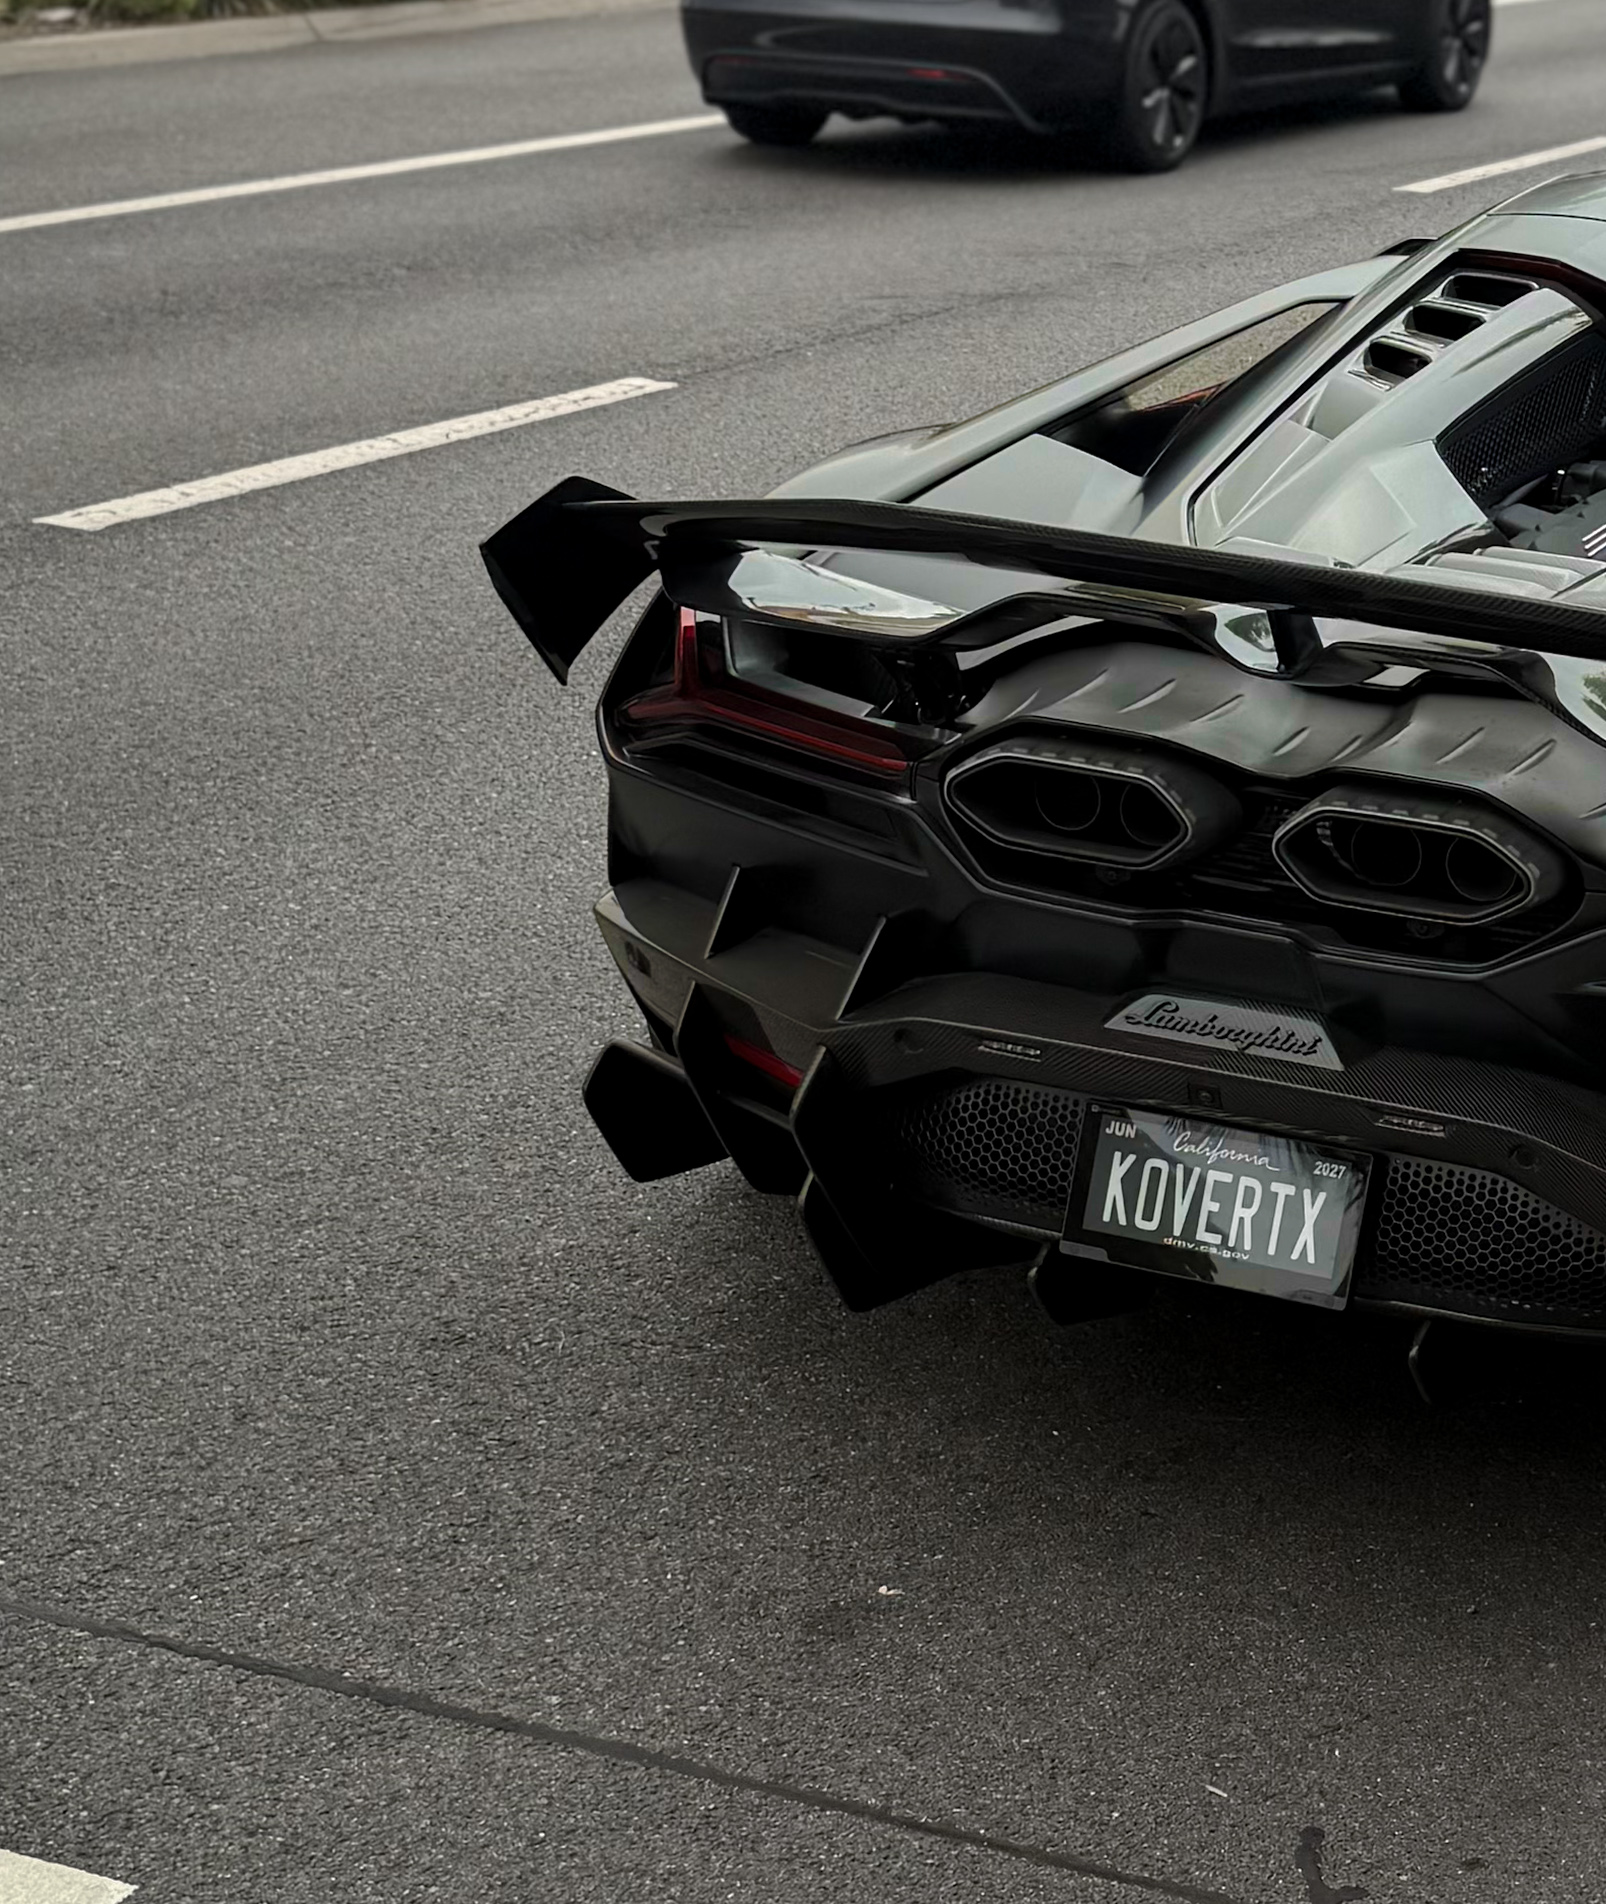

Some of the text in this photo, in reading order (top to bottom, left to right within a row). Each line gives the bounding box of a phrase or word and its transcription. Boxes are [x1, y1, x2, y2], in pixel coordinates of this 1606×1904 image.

[1125, 1000, 1324, 1057] Lamborghini
[1105, 1120, 1137, 1139] JUN
[1173, 1131, 1281, 1172] California
[1313, 1161, 1347, 1180] 2027
[1102, 1151, 1327, 1264] KOVERTX
[1163, 1236, 1250, 1261] dmv.ca.gov
